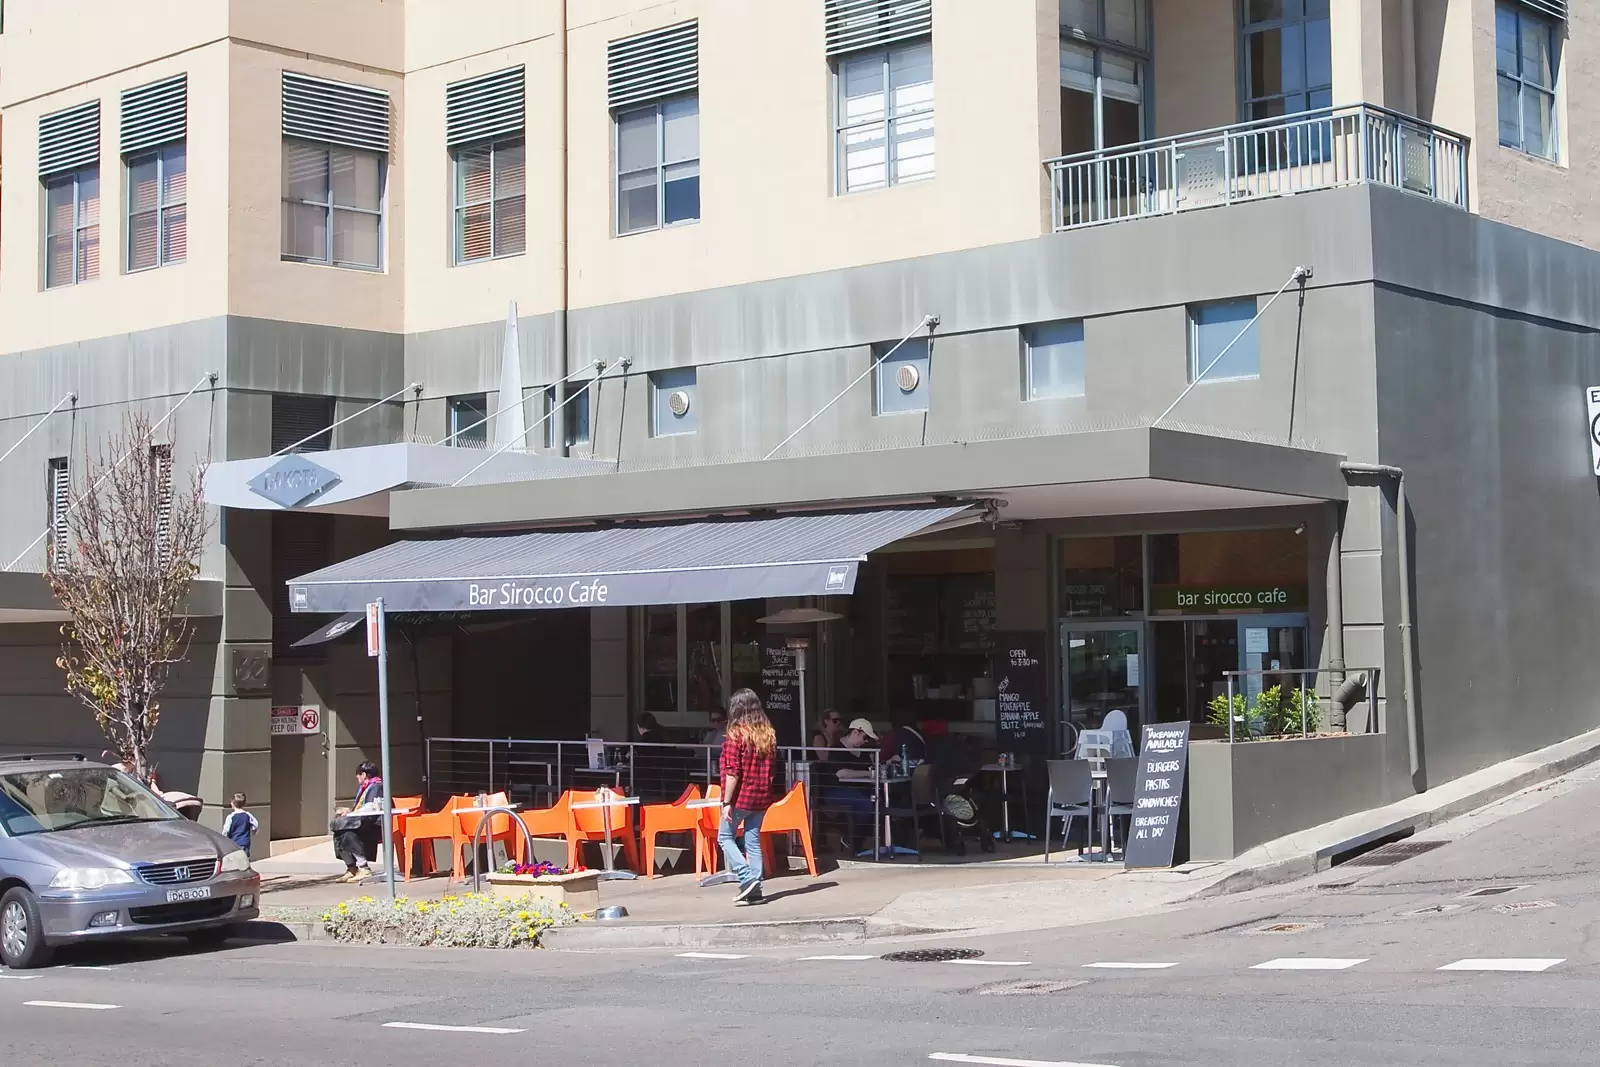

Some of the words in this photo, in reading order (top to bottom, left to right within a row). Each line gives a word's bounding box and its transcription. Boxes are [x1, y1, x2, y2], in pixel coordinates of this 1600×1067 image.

[469, 583, 497, 605] Bar
[500, 582, 564, 605] Sirocco
[568, 578, 608, 603] Cafe
[1177, 591, 1200, 606] bar
[1204, 590, 1252, 605] sirocco
[1257, 588, 1287, 603] cafe
[1009, 649, 1026, 658] OPEN
[998, 676, 1010, 692] NEW
[999, 693, 1020, 702] MANGO
[999, 702, 1031, 711] PINEAPPLE
[271, 724, 285, 733] KEEP
[286, 724, 298, 733] OUT
[1001, 721, 1020, 730] BLITZ
[1145, 727, 1185, 739] TAKEAWAY
[1144, 739, 1184, 752] AVAILABLE
[1146, 760, 1180, 773] BURGERS
[1145, 778, 1171, 791] PASTAS
[1137, 796, 1179, 809] SANDWICHES
[1135, 815, 1170, 827] BREAKFAST
[1135, 829, 1148, 840] ALL
[1151, 827, 1165, 838] DAY
